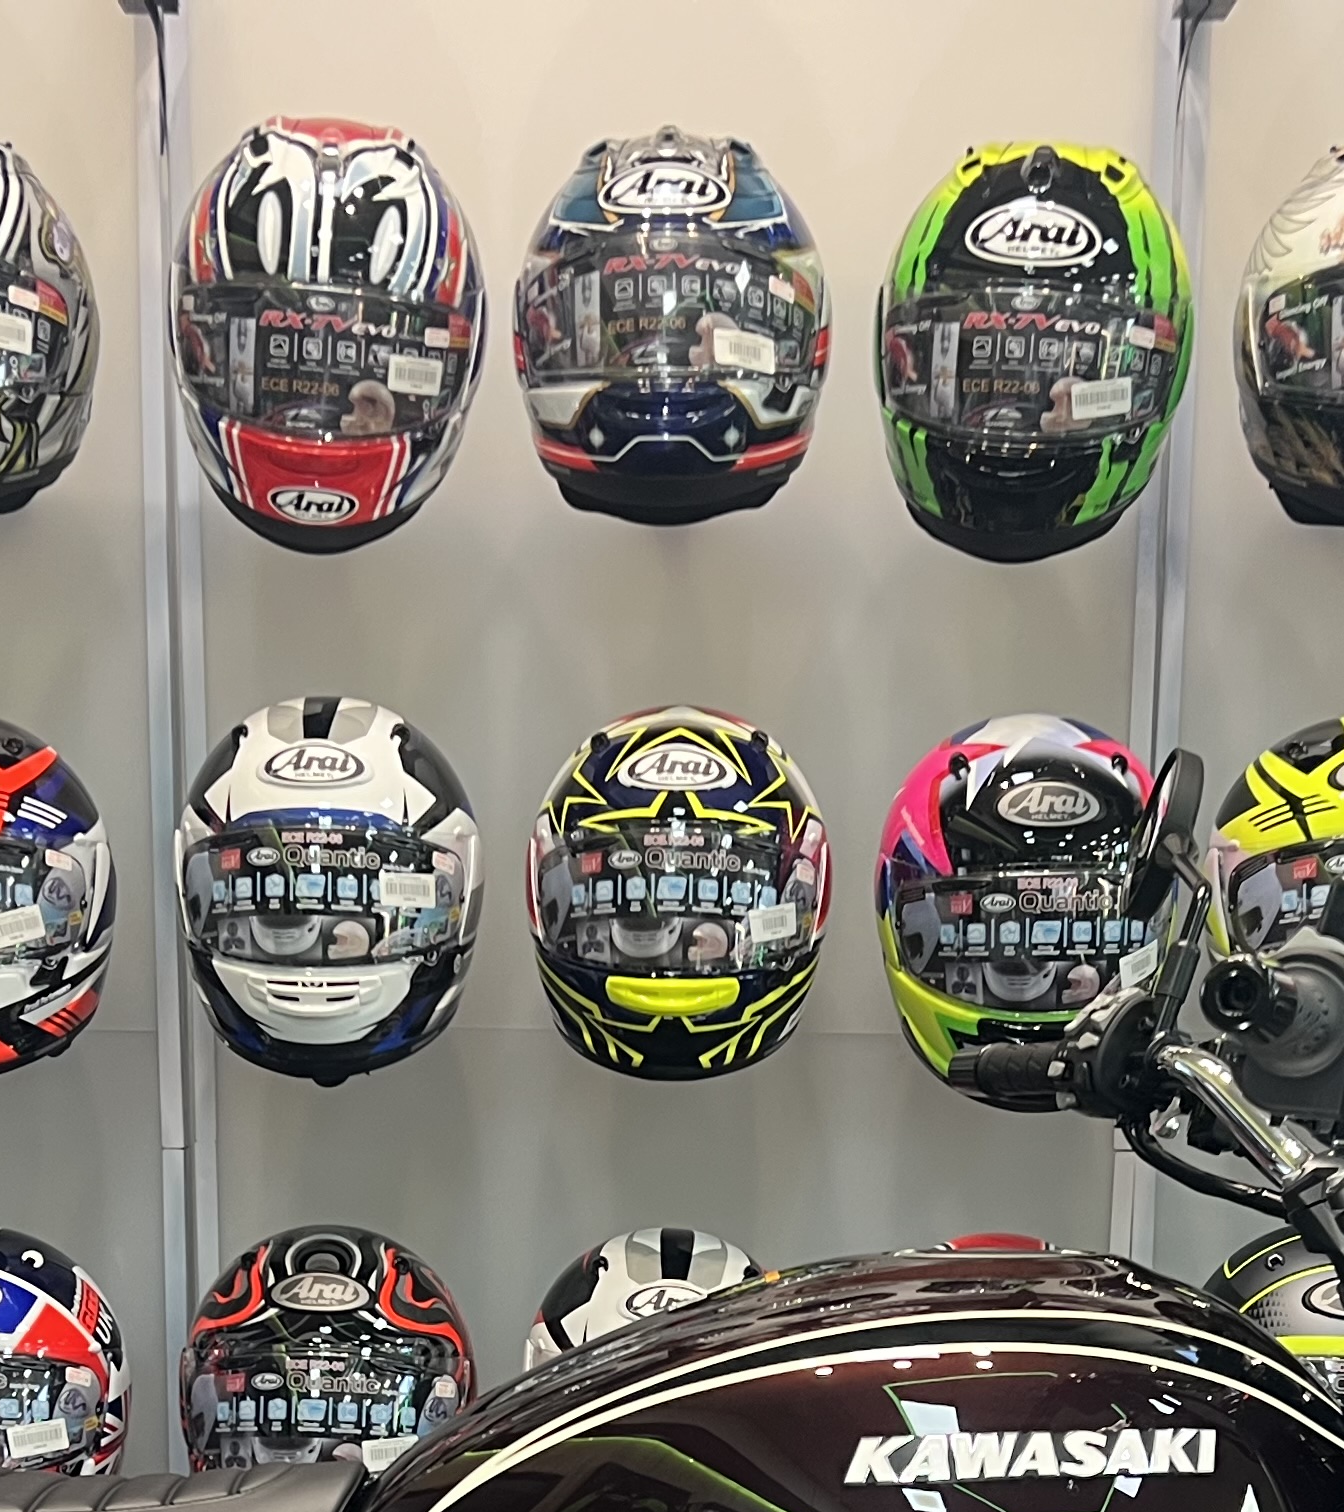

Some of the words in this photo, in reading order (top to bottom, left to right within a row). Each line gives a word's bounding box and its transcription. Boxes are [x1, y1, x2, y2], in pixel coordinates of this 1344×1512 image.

[996, 212, 1082, 246] Arai
[963, 311, 1059, 331] RX-7V
[283, 490, 348, 514] Arai
[284, 749, 352, 773] Arai
[643, 753, 714, 778] Arai
[1014, 791, 1088, 815] Arai
[251, 850, 276, 861] Arai
[282, 845, 380, 869] Quantic
[613, 854, 639, 866] Arai
[644, 848, 741, 871] Quantic
[984, 896, 1012, 908] Arai
[1019, 891, 1113, 912] Quantic
[288, 1276, 358, 1301] Arai
[95, 1307, 115, 1346] UK
[253, 1374, 282, 1387] Arai
[287, 1371, 380, 1393] Quantic
[844, 1429, 1217, 1485] KAWASAKI
